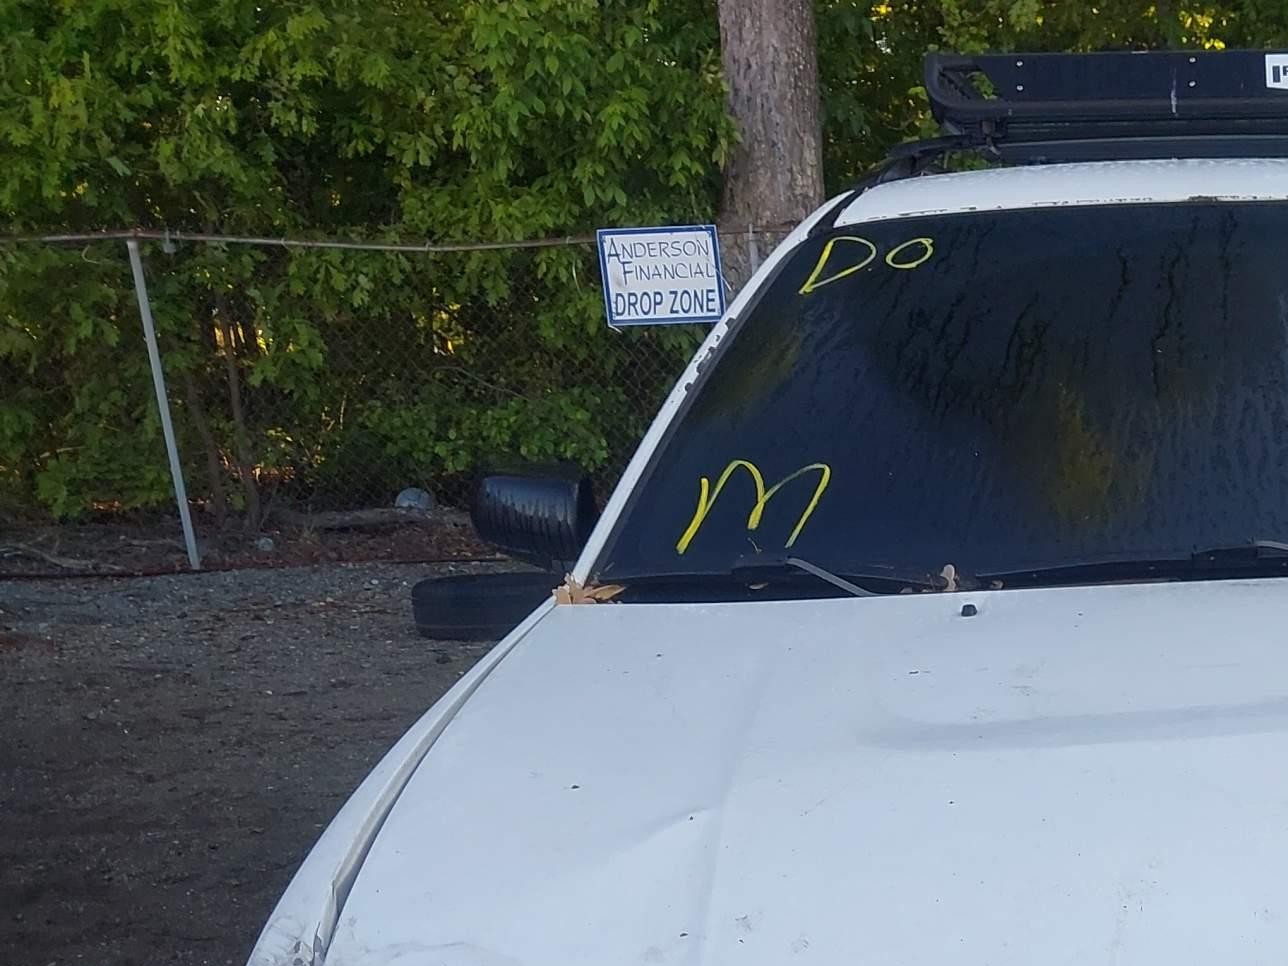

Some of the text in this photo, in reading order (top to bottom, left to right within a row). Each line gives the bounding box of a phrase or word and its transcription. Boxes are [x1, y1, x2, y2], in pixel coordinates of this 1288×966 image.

[607, 238, 709, 263] ANDERSON
[621, 260, 715, 285] FINANCIAL
[615, 289, 716, 316] DROP ZONE
